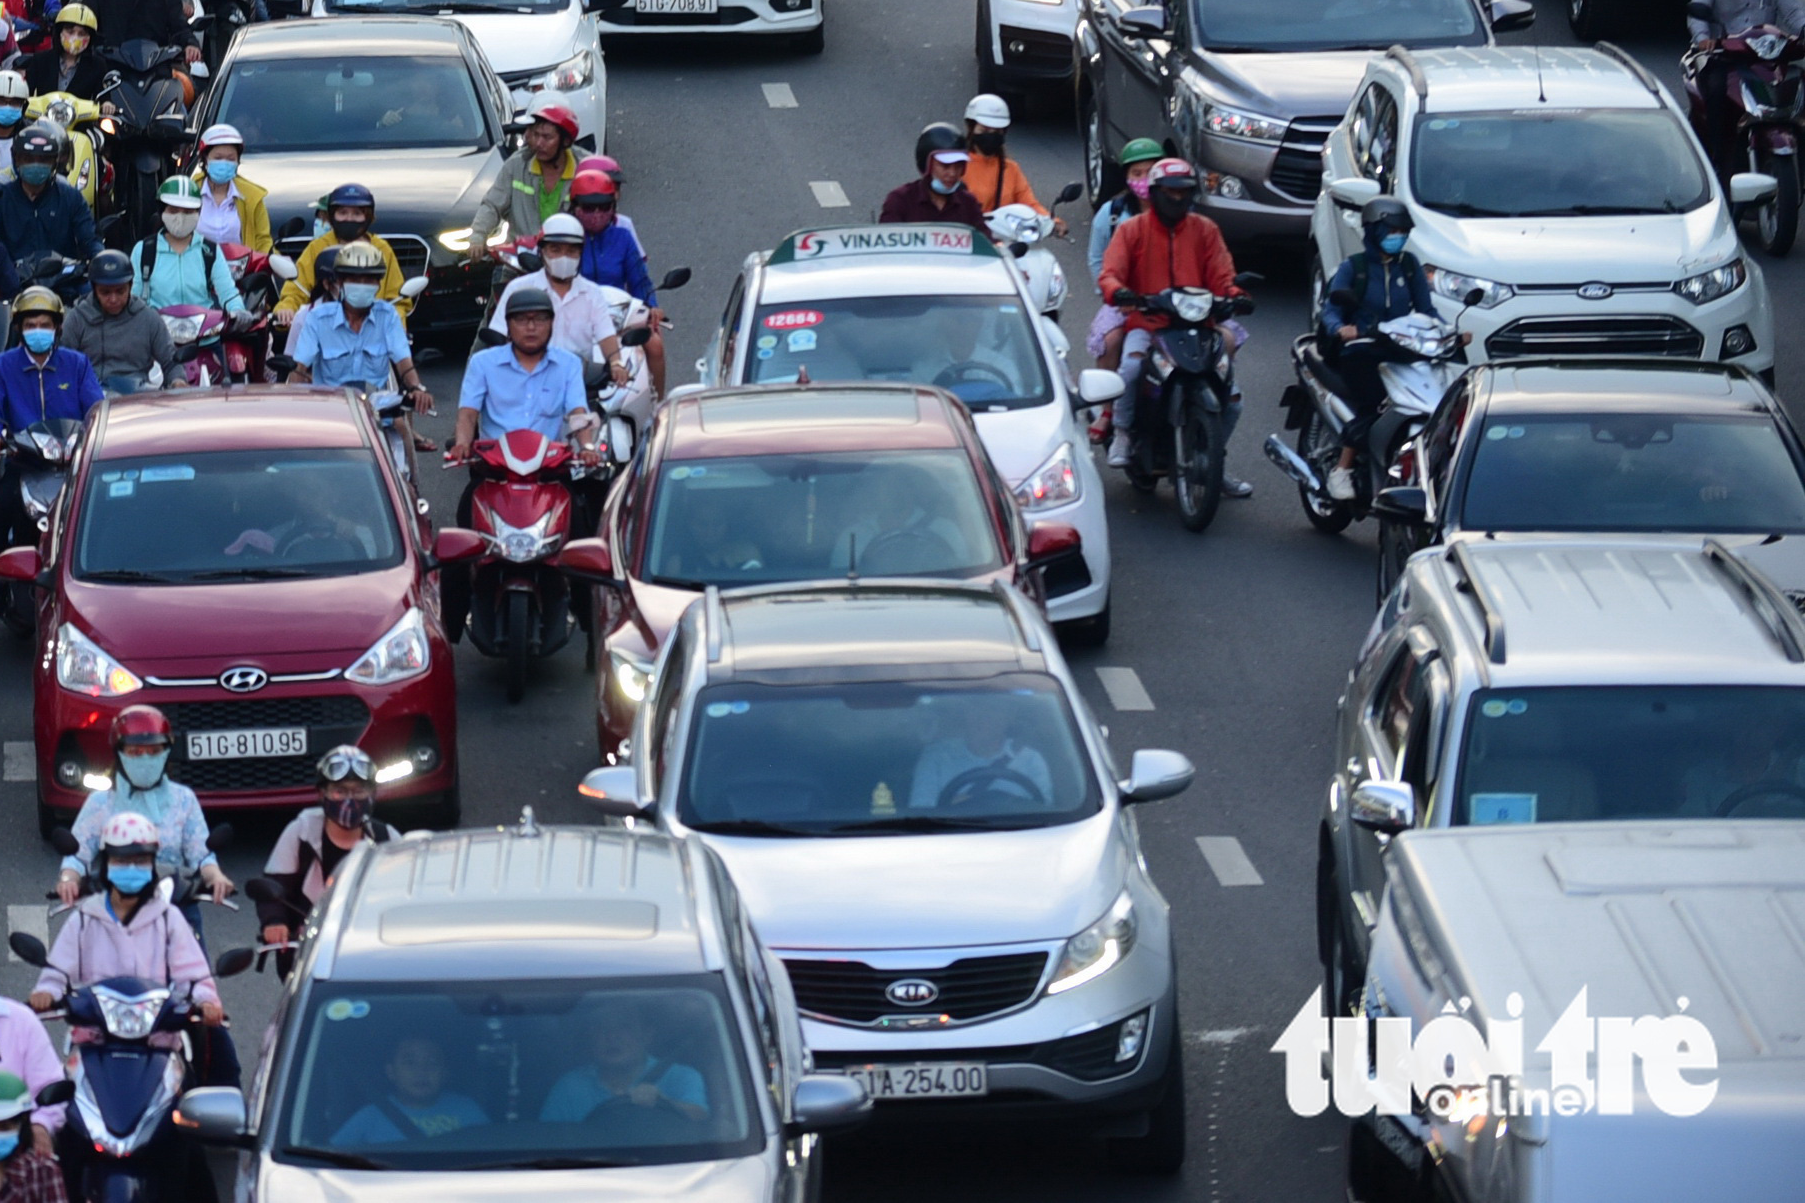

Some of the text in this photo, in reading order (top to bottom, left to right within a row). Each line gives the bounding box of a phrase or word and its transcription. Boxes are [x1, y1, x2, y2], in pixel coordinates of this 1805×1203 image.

[839, 231, 972, 249] VINASUN TAXI
[190, 731, 304, 758] 51G-810.95
[893, 984, 930, 1001] KIA
[851, 1065, 984, 1096] 51A-254.00
